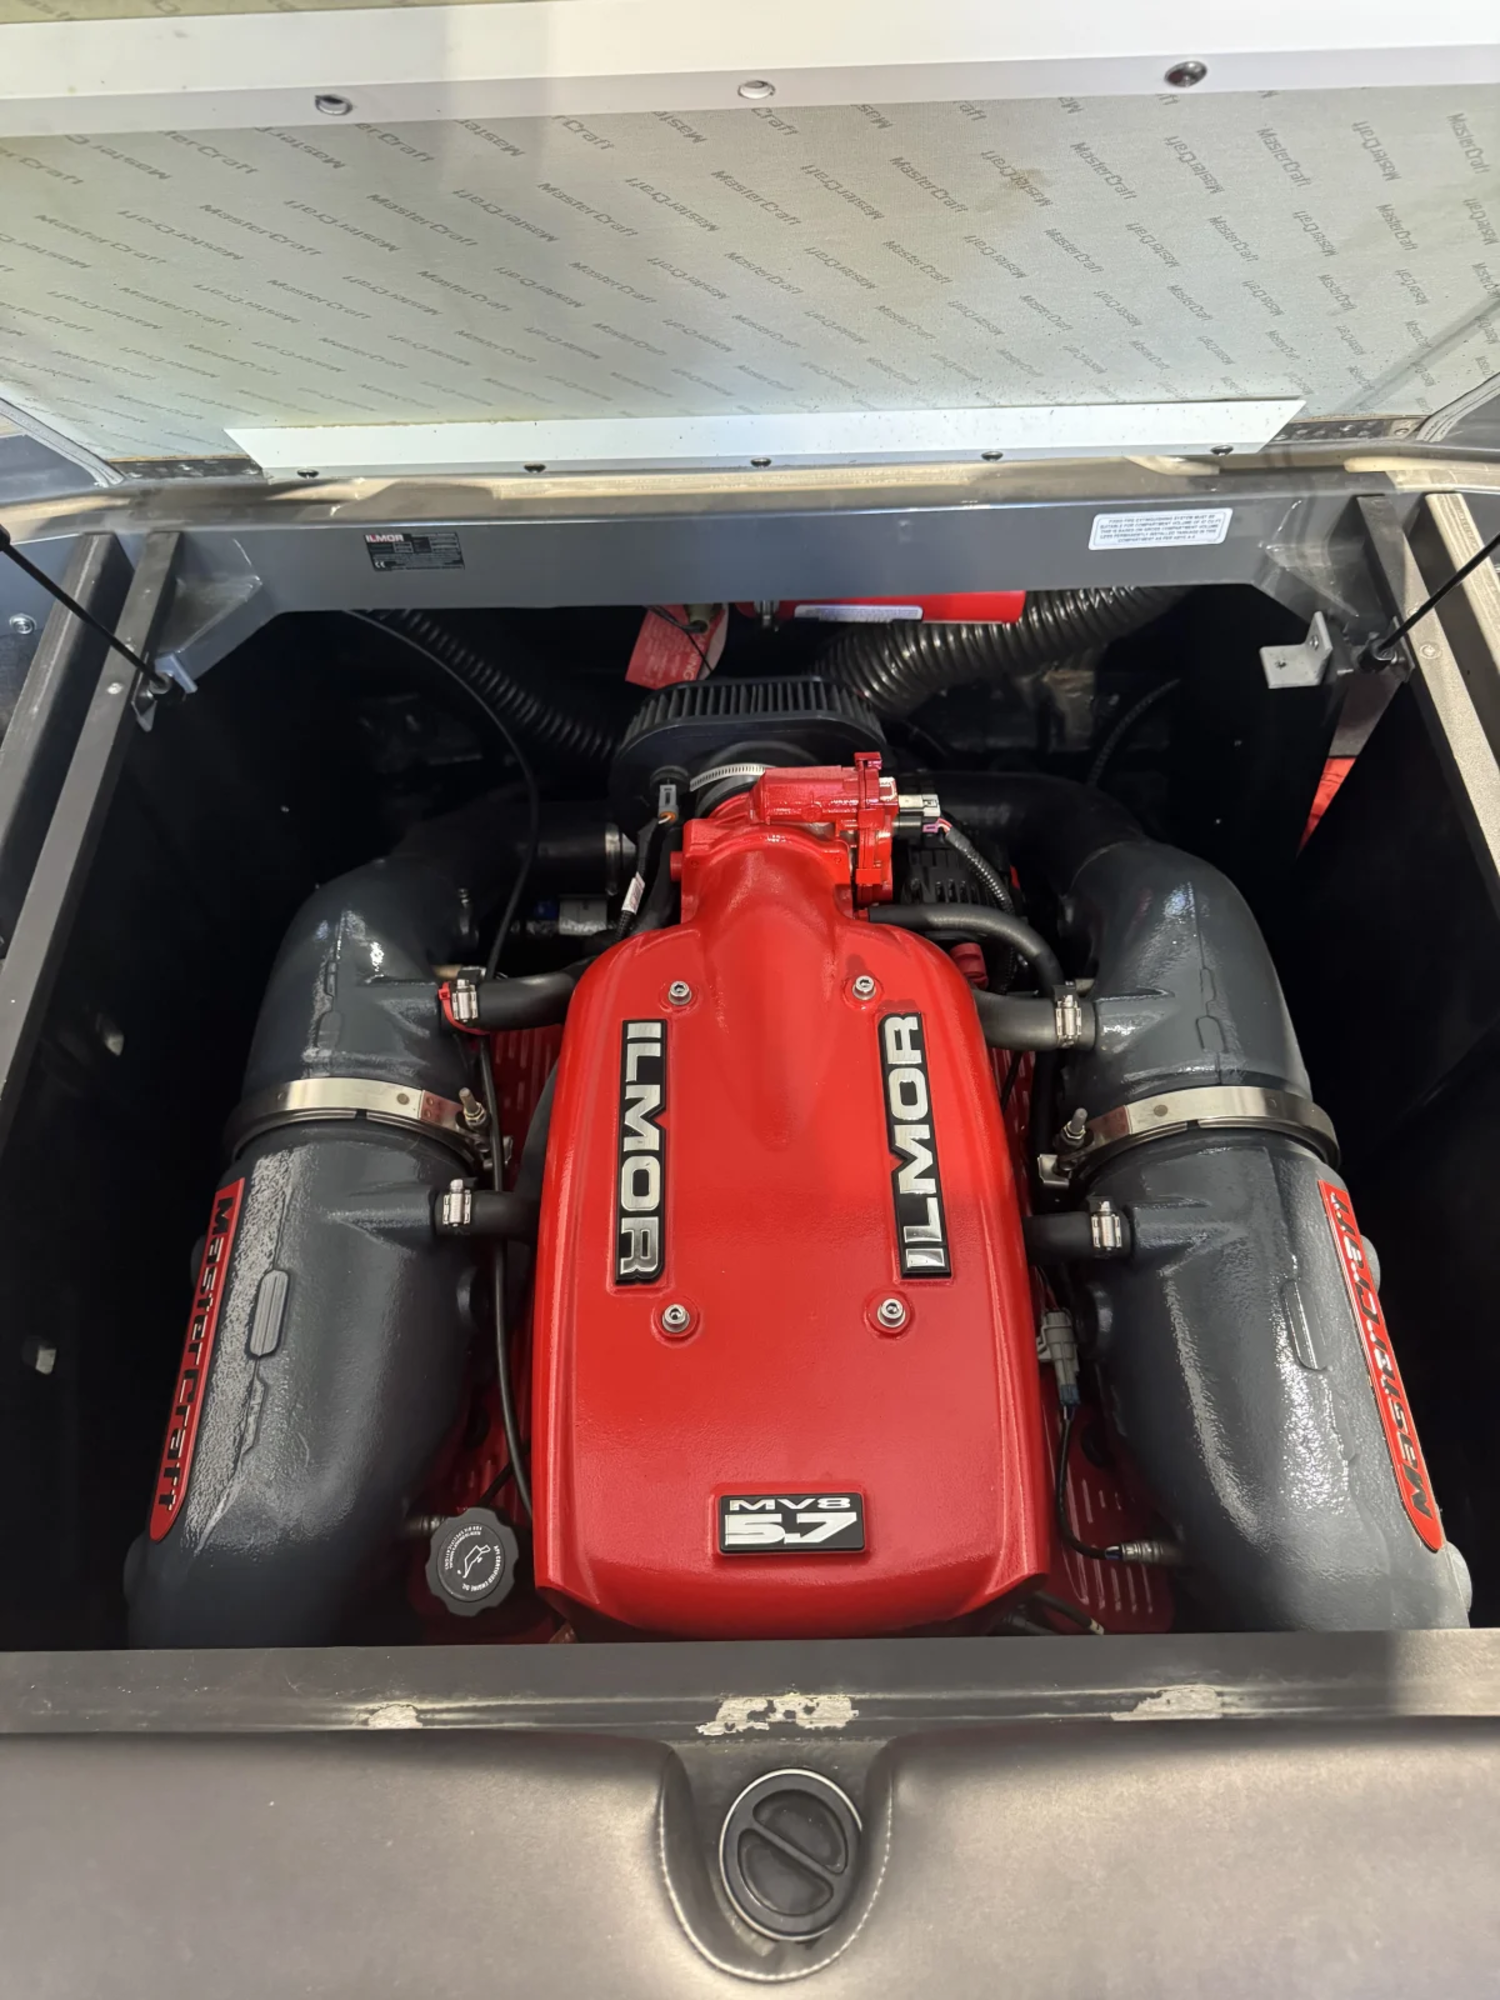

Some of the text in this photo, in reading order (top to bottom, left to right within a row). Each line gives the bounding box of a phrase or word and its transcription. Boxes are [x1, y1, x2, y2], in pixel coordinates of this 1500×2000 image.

[1071, 142, 1137, 200] MasterCraft
[1165, 136, 1223, 193] MasterCraft
[1257, 127, 1312, 188] MasterCraft
[1352, 121, 1400, 182] MasterCraft
[1447, 113, 1490, 175] MasterCraft
[538, 182, 638, 237] MasterCraft
[625, 178, 719, 232] MasterCraft
[711, 170, 801, 226] MasterCraft
[801, 164, 884, 220] MasterCraft
[890, 156, 969, 213] MasterCraft
[34, 214, 166, 264] MasterCraft
[118, 210, 243, 261] MasterCraft
[199, 203, 322, 256] MasterCraft
[284, 200, 400, 252] MasterCraft
[367, 194, 478, 246] MasterCraft
[454, 189, 558, 241] MasterCraft
[620, 1022, 662, 1276] ILMOR
[884, 1015, 946, 1269] ILMOR
[158, 1197, 235, 1511] MasterCraft
[1330, 1191, 1433, 1520] MasterCraft
[725, 1511, 857, 1546] 5.7
[729, 1497, 851, 1511] MV8
